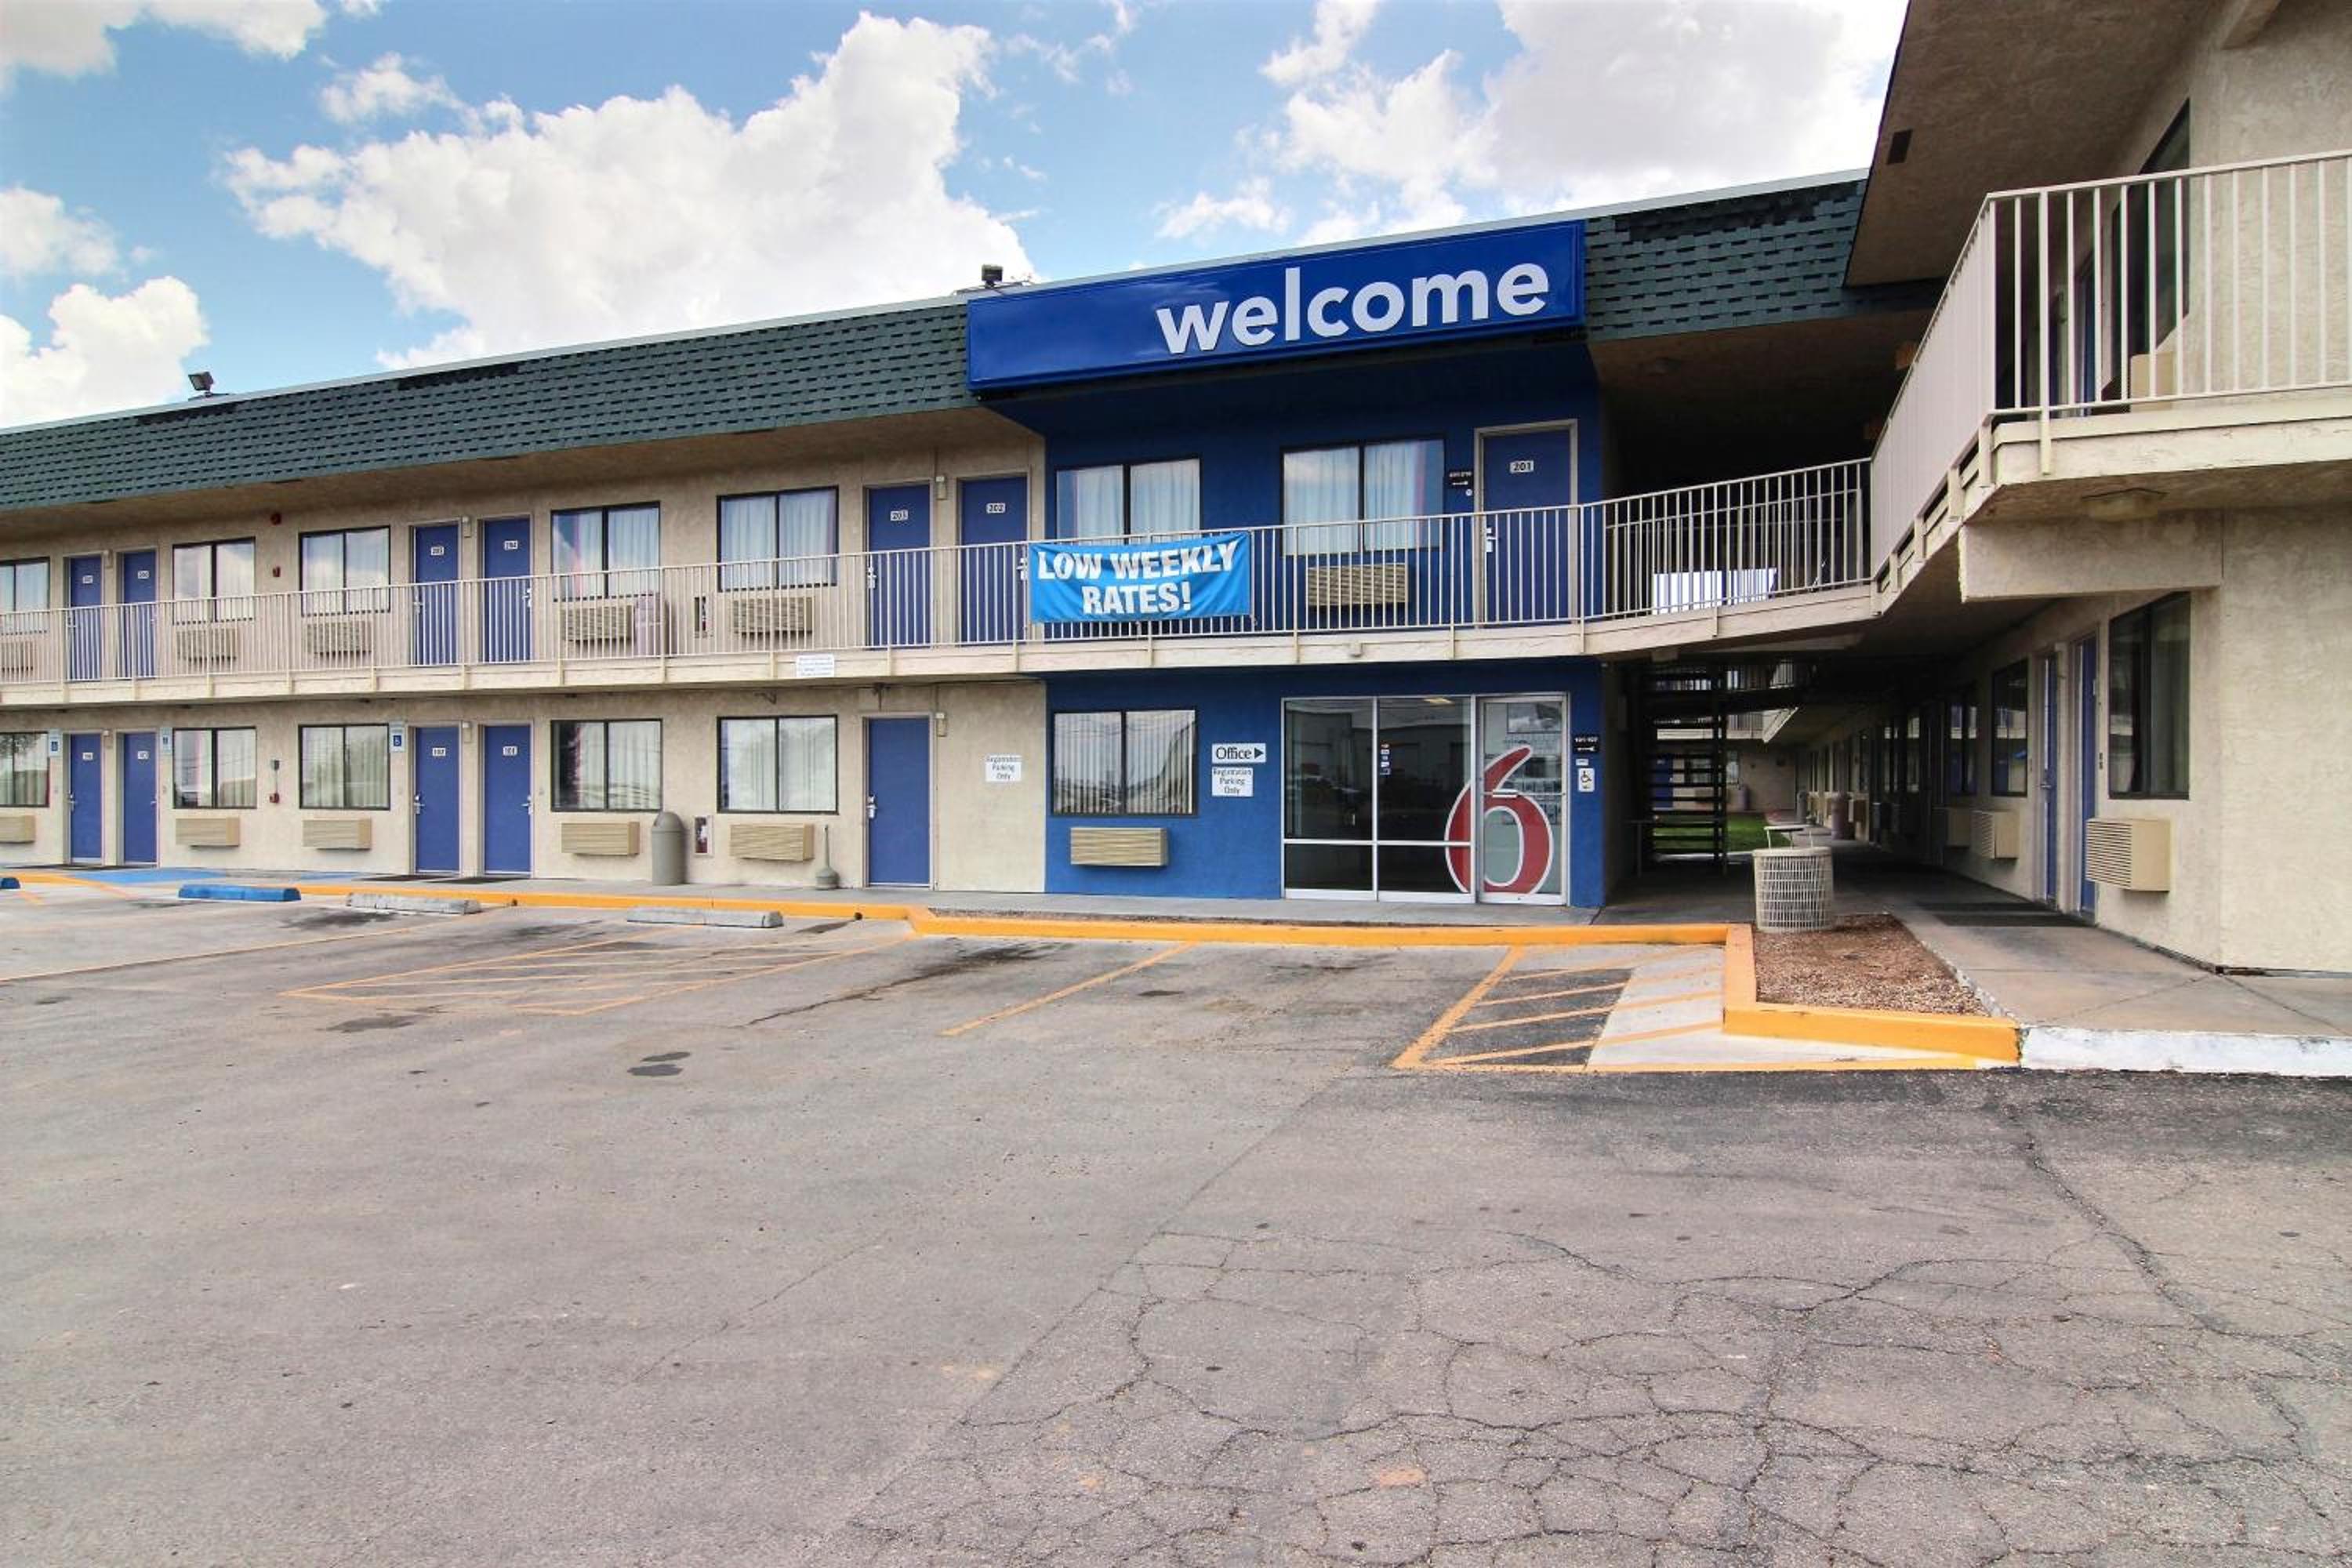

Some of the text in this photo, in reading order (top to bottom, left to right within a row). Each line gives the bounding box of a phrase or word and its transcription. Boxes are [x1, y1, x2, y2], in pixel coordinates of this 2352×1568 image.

[1156, 263, 1550, 354] welcome
[1512, 461, 1532, 472] 201
[1037, 540, 1239, 580] LOW WEEKLY
[1081, 581, 1192, 615] RATES!
[1215, 746, 1252, 760] Office
